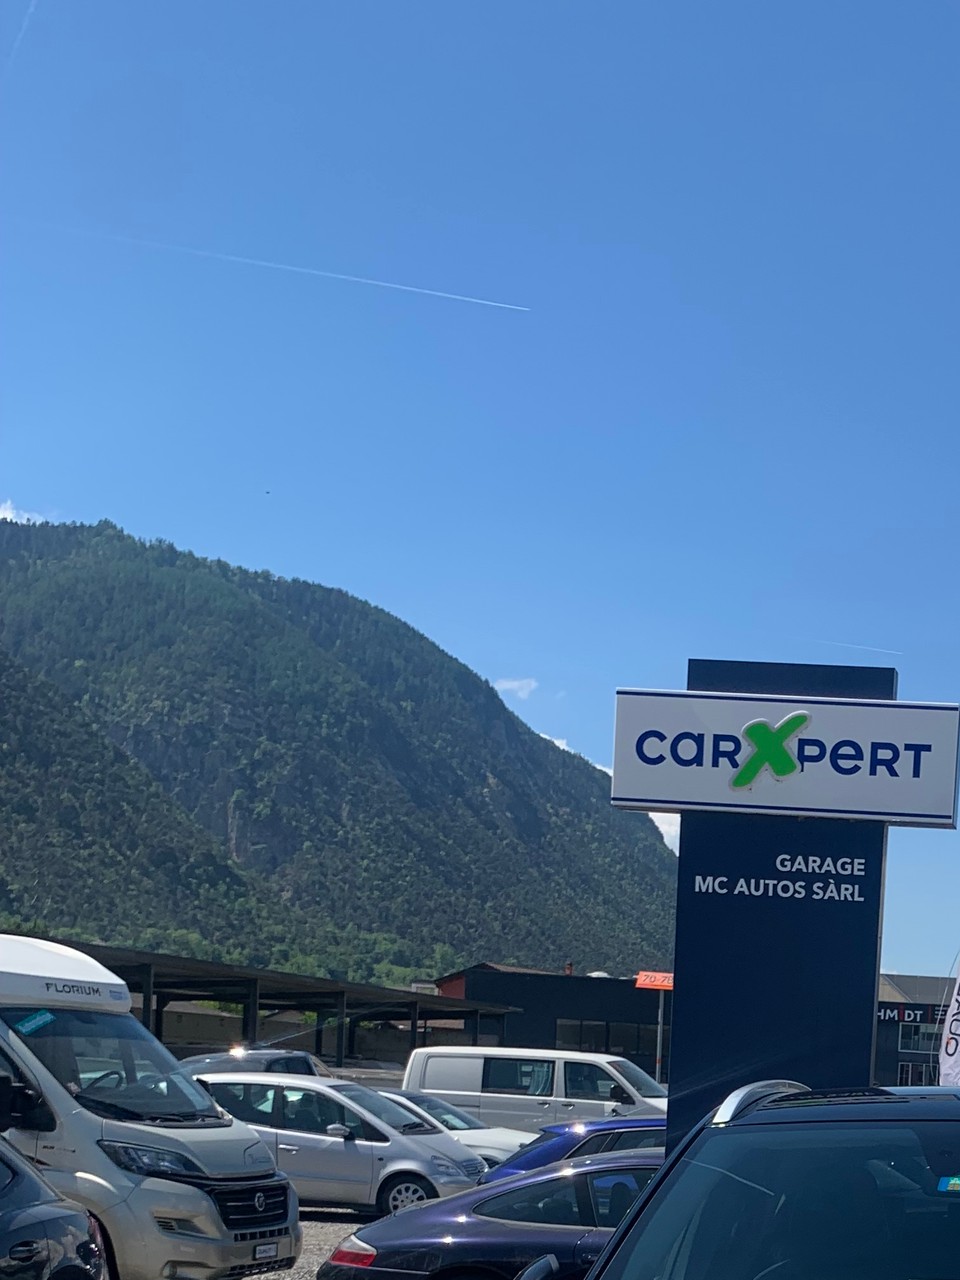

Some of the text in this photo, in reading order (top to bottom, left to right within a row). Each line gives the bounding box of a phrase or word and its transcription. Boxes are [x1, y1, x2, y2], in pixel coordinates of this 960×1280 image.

[776, 854, 866, 876] GARAGE
[694, 875, 865, 902] MC AUTOS SÀRL
[45, 983, 101, 997] FLORIUM
